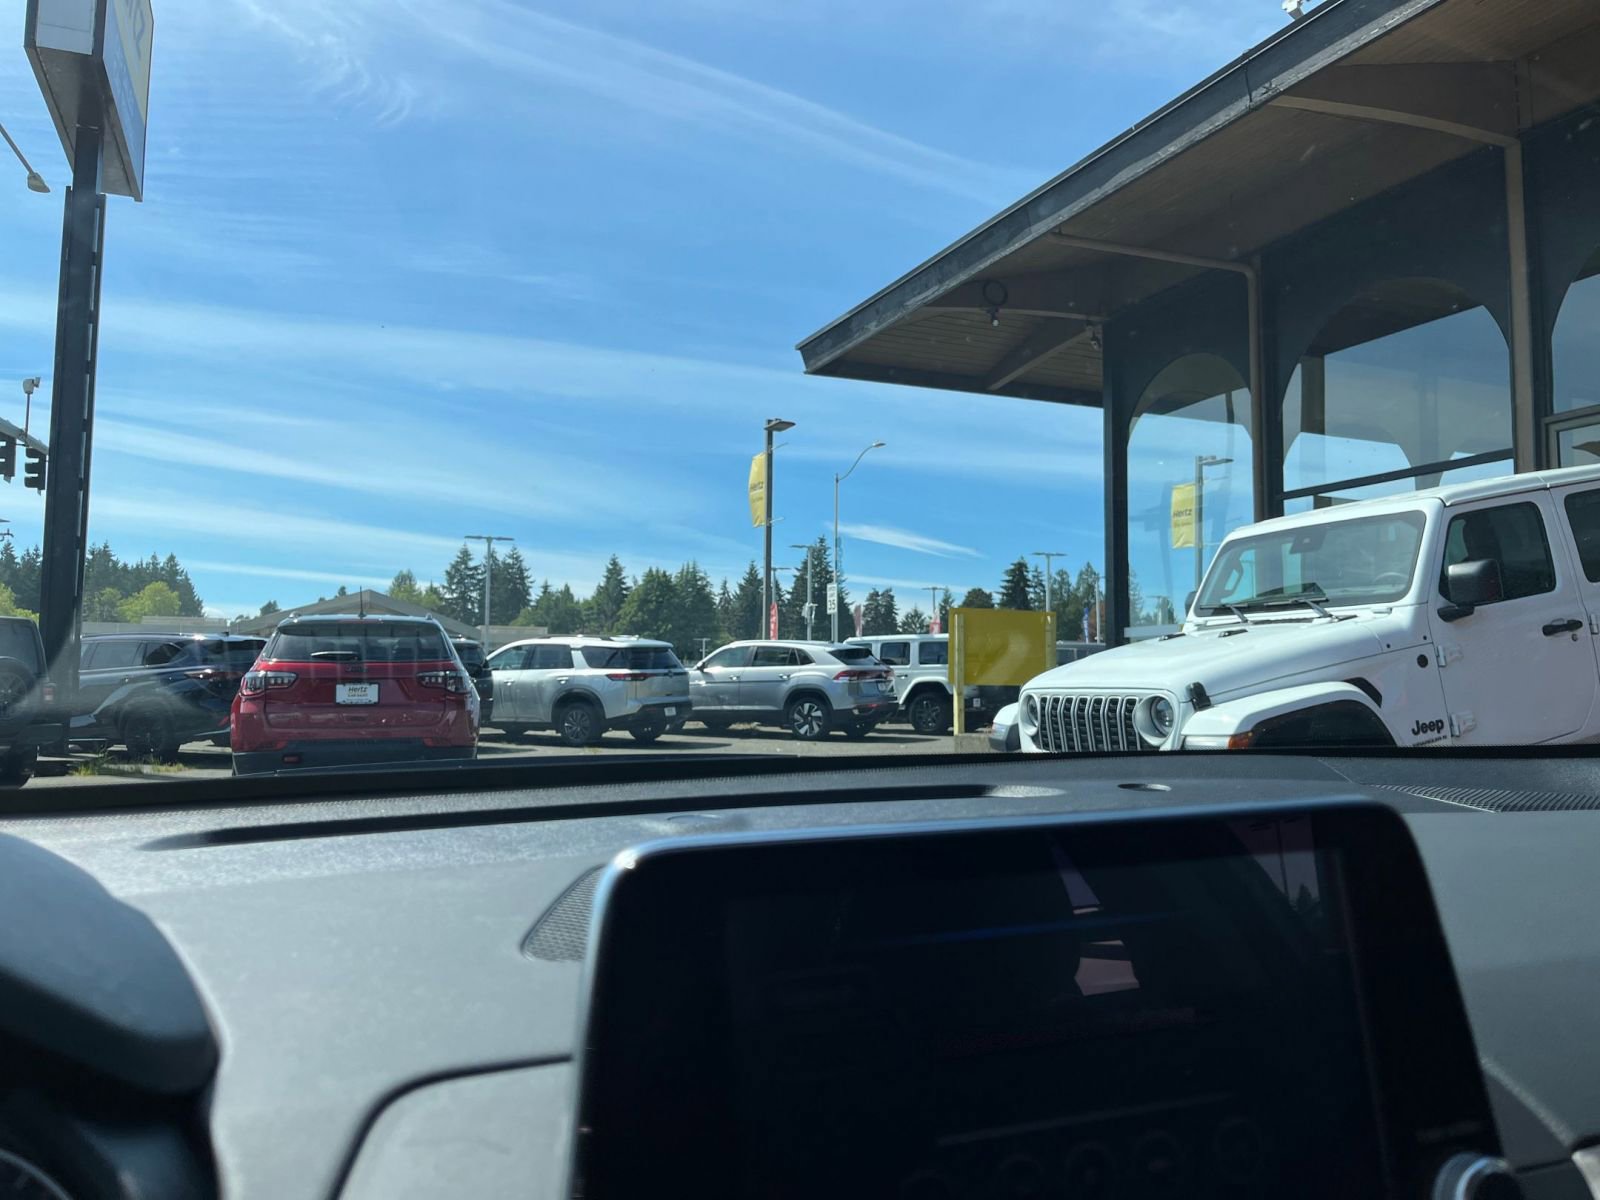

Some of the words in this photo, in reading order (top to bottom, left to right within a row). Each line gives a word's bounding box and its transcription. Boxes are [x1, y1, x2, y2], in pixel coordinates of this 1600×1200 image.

[1173, 508, 1192, 518] Hertz
[828, 599, 836, 610] 35
[1411, 718, 1444, 735] Jeep
